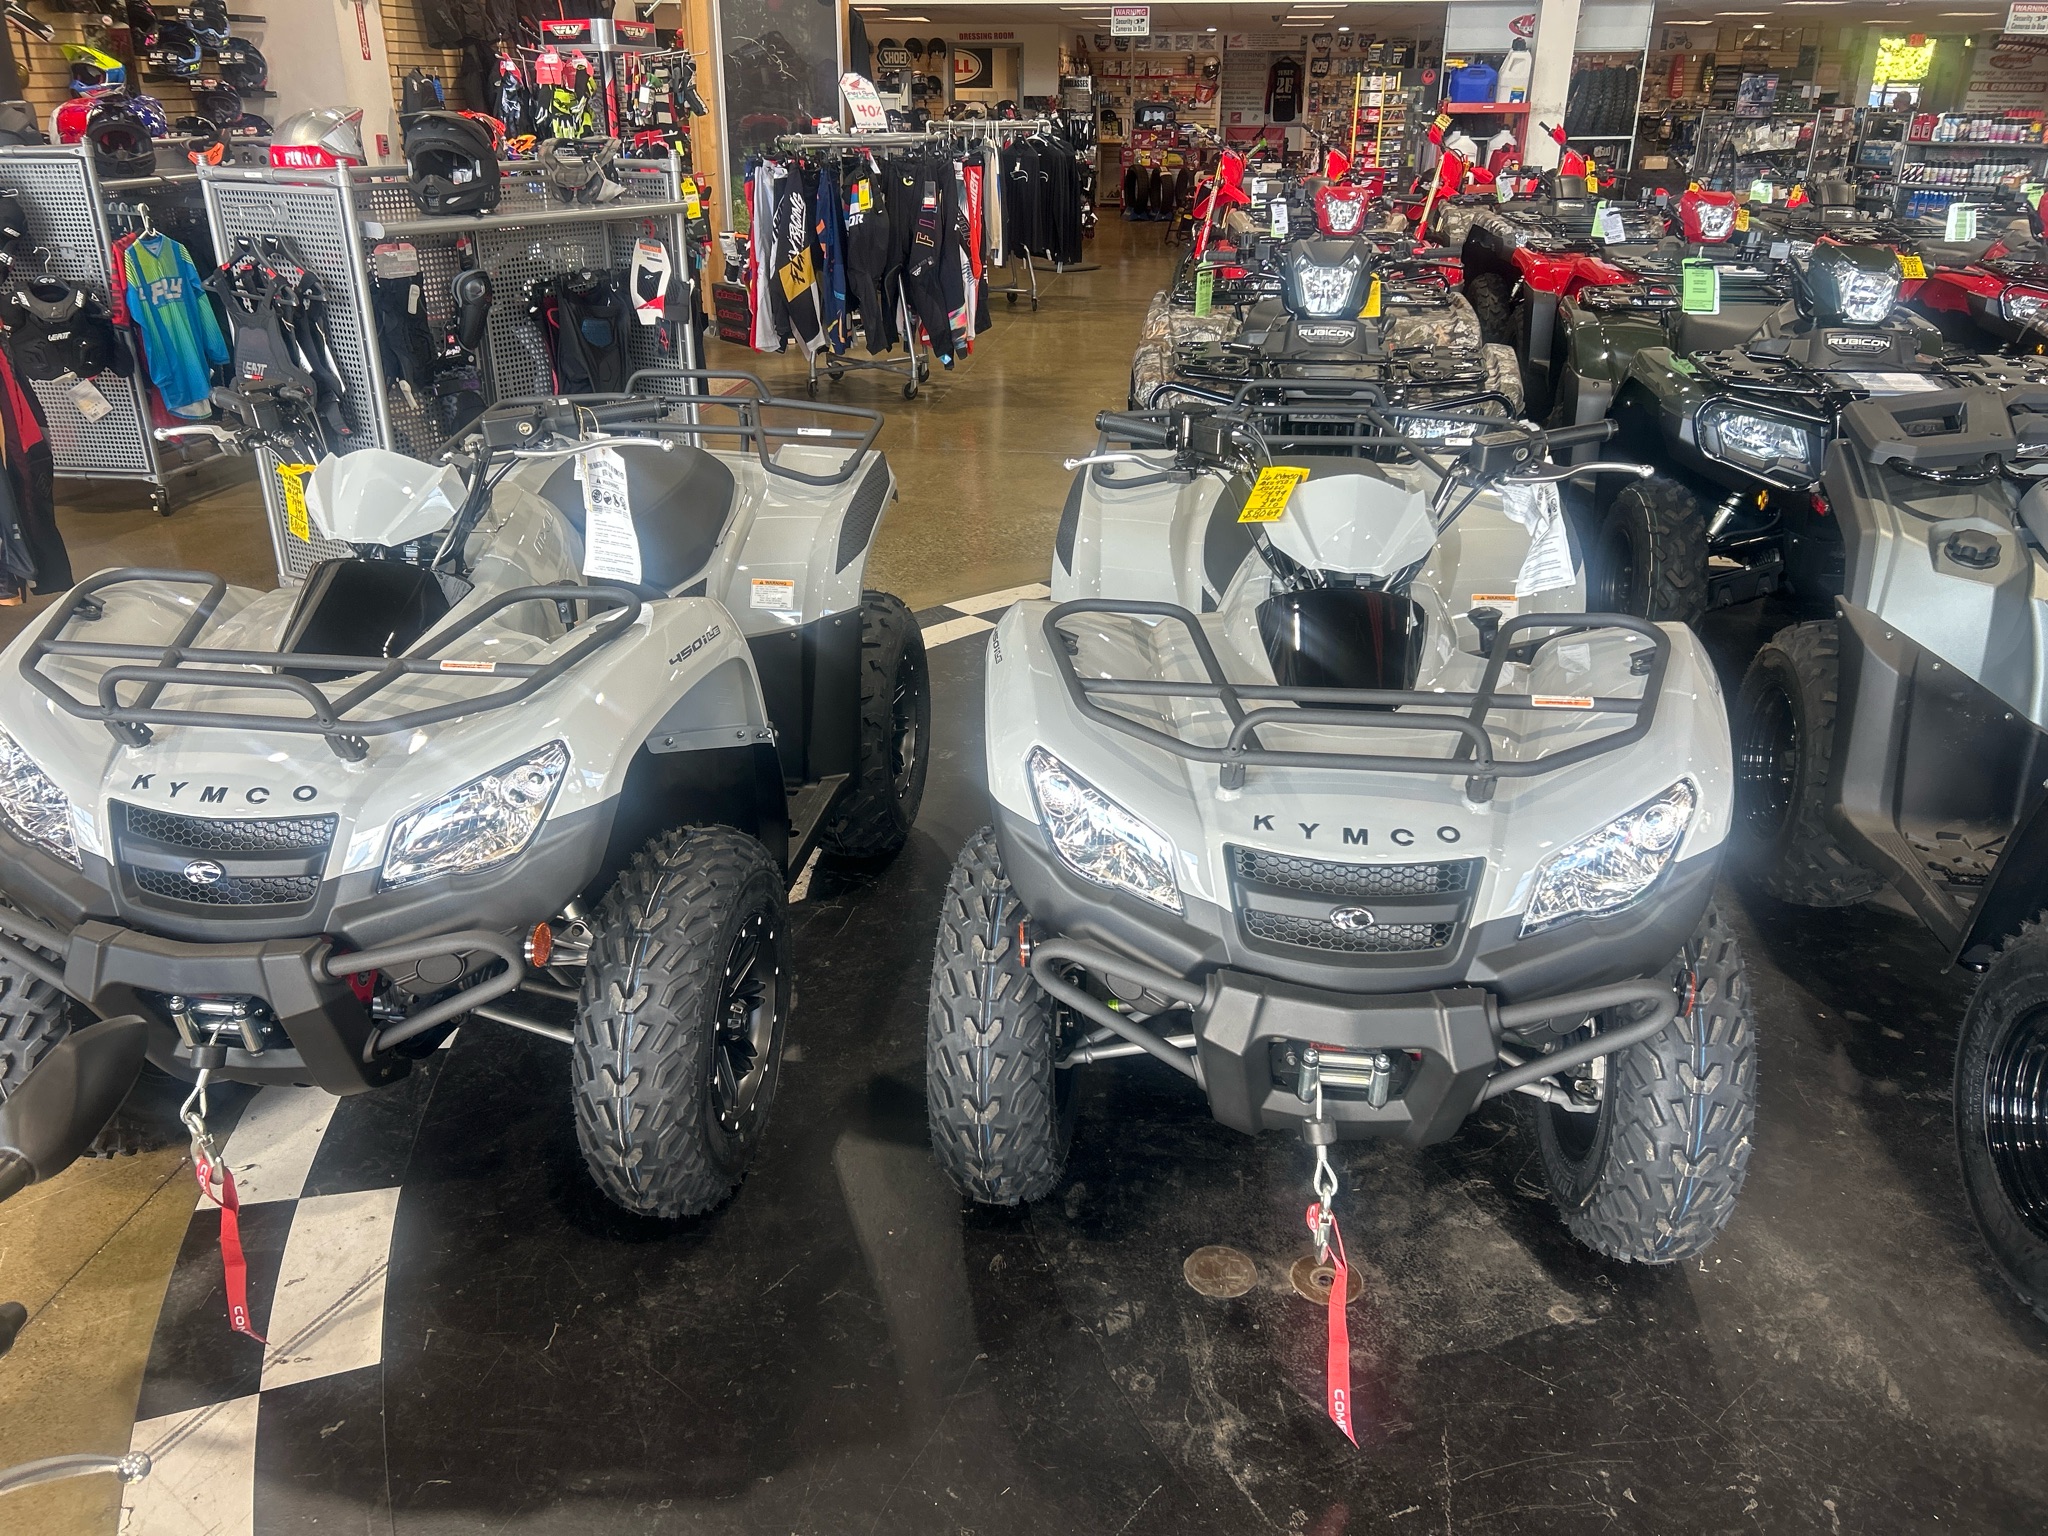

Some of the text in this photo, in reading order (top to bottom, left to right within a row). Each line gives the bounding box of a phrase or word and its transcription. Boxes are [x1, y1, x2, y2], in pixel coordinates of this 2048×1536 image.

[959, 32, 1015, 40] DRESSING ROOM
[884, 52, 907, 65] SHOEI
[1971, 83, 2044, 92] OIL CHANGES
[857, 104, 882, 117] 40%
[150, 278, 183, 305] FLY
[48, 331, 72, 342] LEATT
[1298, 329, 1355, 338] RUBICON
[1827, 337, 1892, 348] RUBICON
[242, 361, 268, 375] LEATT
[131, 773, 318, 804] KYMCO
[1253, 814, 1461, 847] KYMCO
